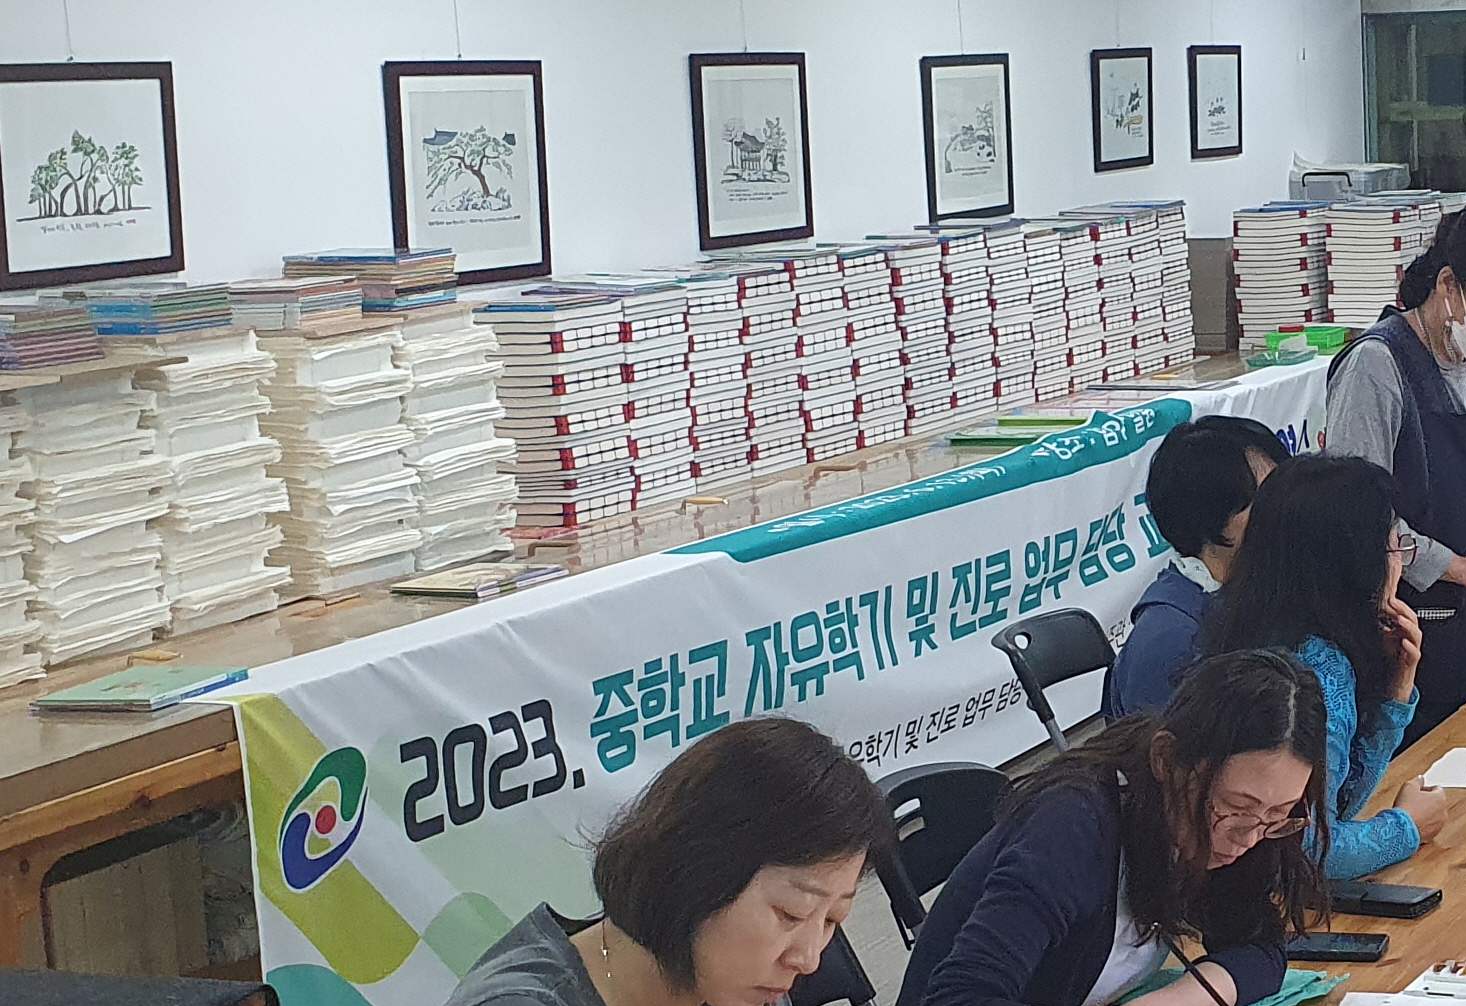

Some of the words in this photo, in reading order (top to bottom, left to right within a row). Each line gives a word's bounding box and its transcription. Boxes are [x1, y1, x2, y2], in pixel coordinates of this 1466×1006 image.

[400, 698, 586, 843] 2023.
[590, 639, 731, 774] 중학교
[743, 584, 899, 718] 자유학기
[906, 571, 939, 659] 및
[949, 548, 1013, 641] 진로
[904, 715, 925, 755] 및
[926, 703, 961, 744] 진로
